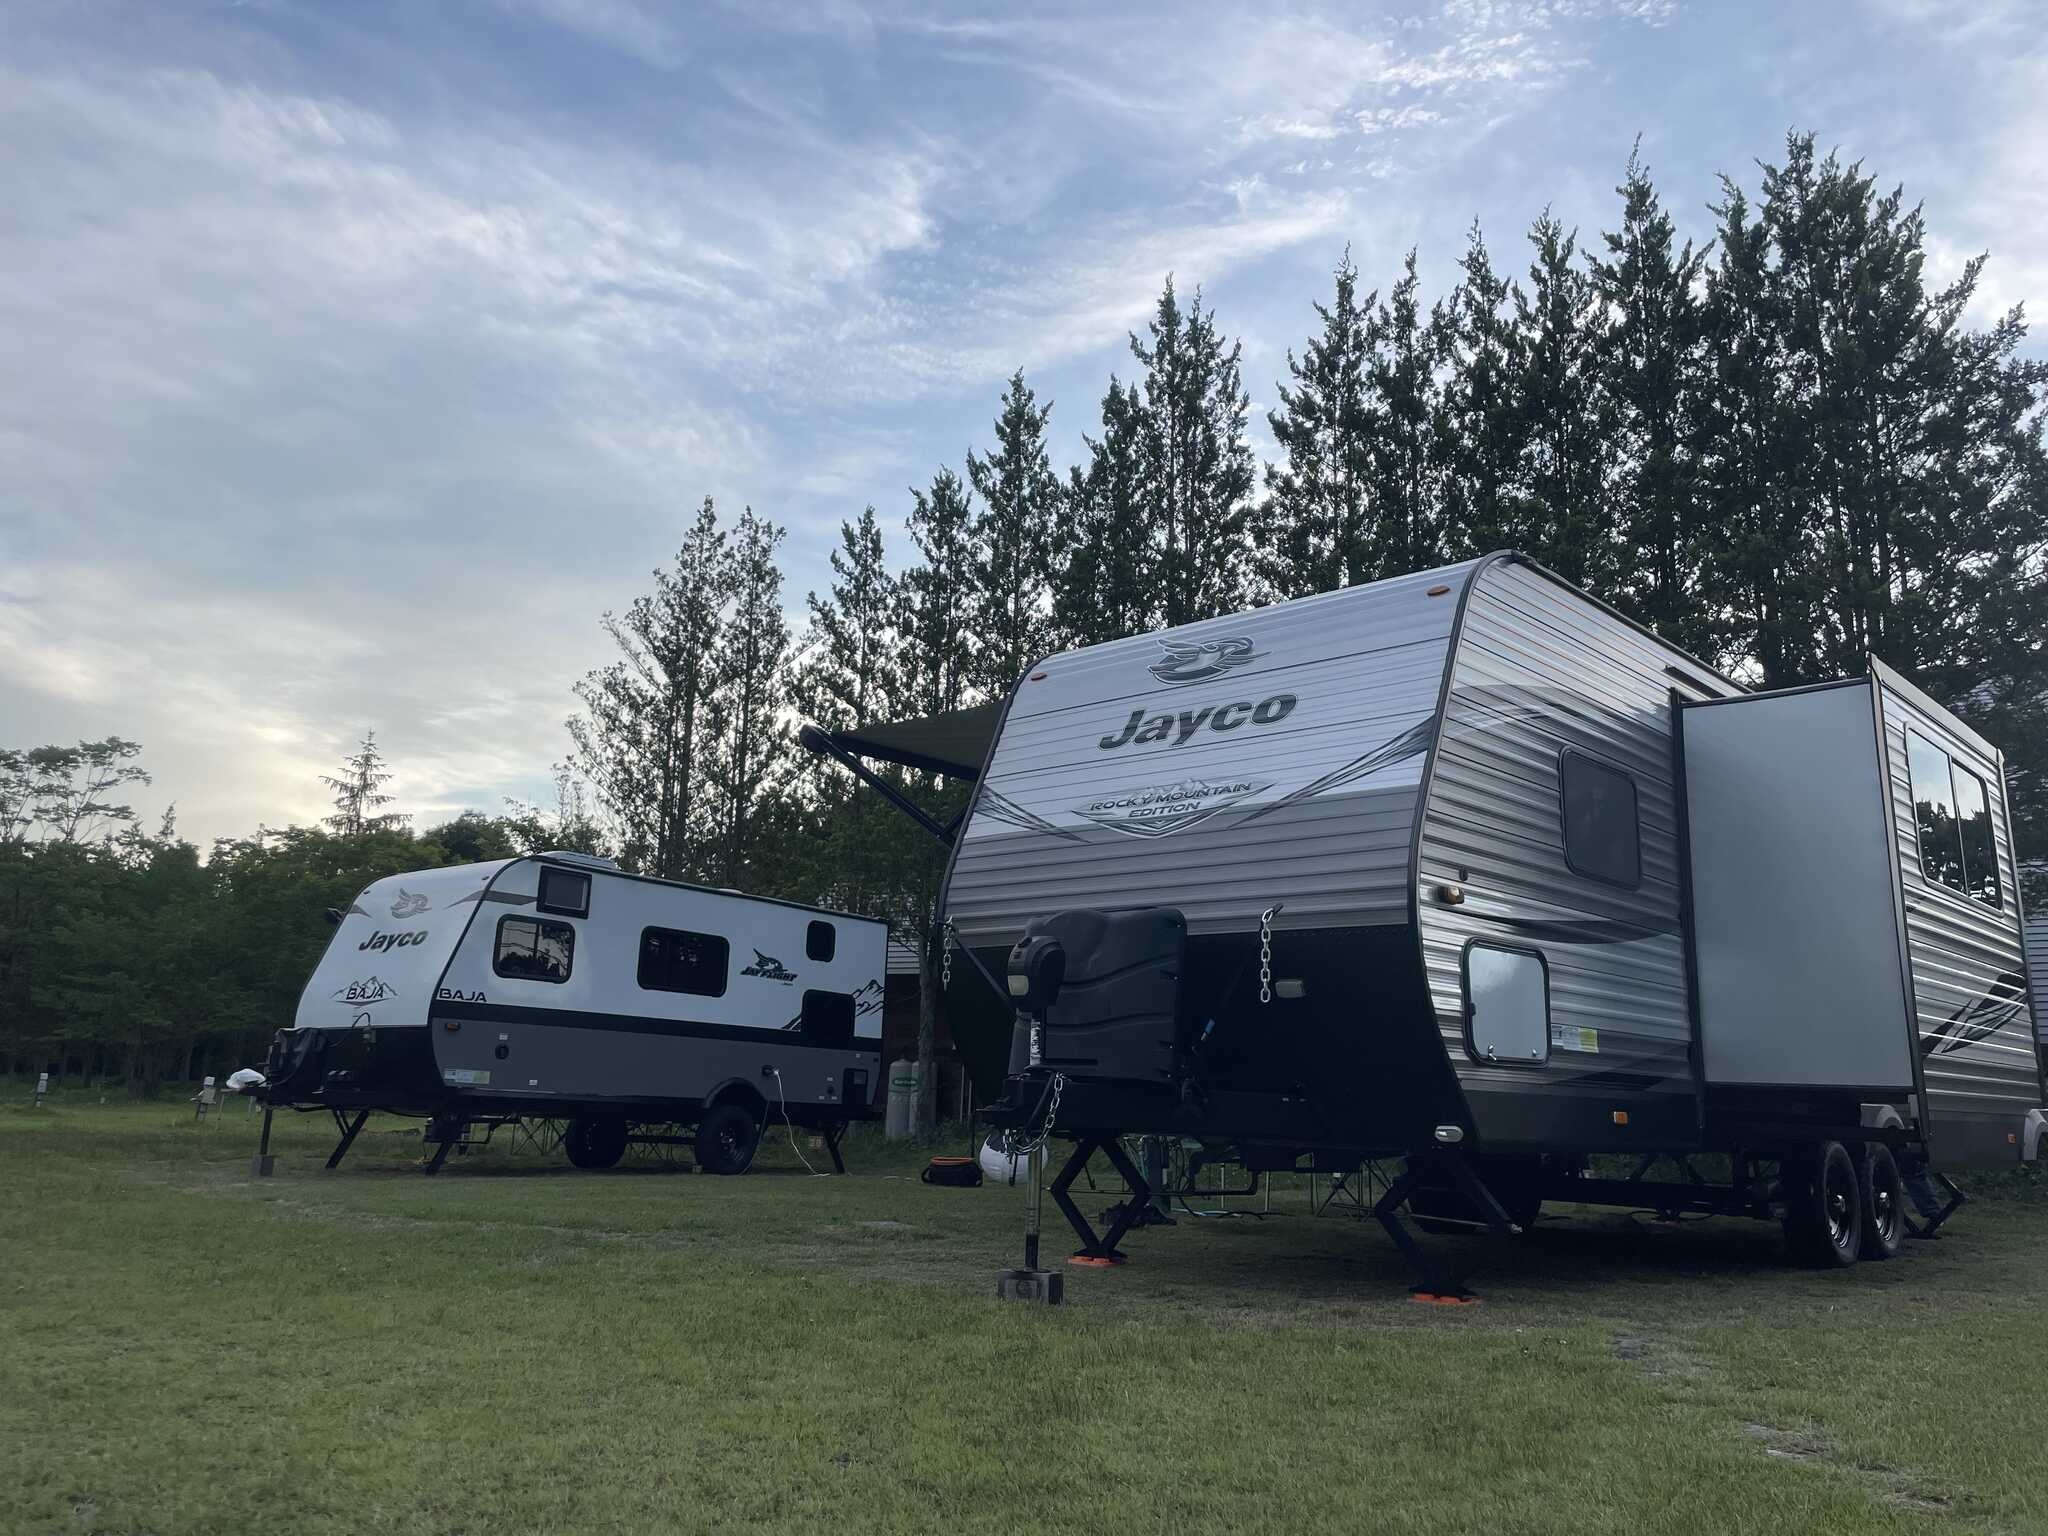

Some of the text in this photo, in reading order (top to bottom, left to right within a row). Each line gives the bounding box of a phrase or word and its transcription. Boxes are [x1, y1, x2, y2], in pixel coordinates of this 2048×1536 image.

[1098, 694, 1298, 750] Jayco
[1090, 782, 1253, 811] ROCKY MOUNTAIN
[1128, 801, 1201, 818] EDITION
[358, 931, 429, 953] Jayco
[346, 986, 384, 1000] BAJA
[439, 988, 487, 1002] BAJA
